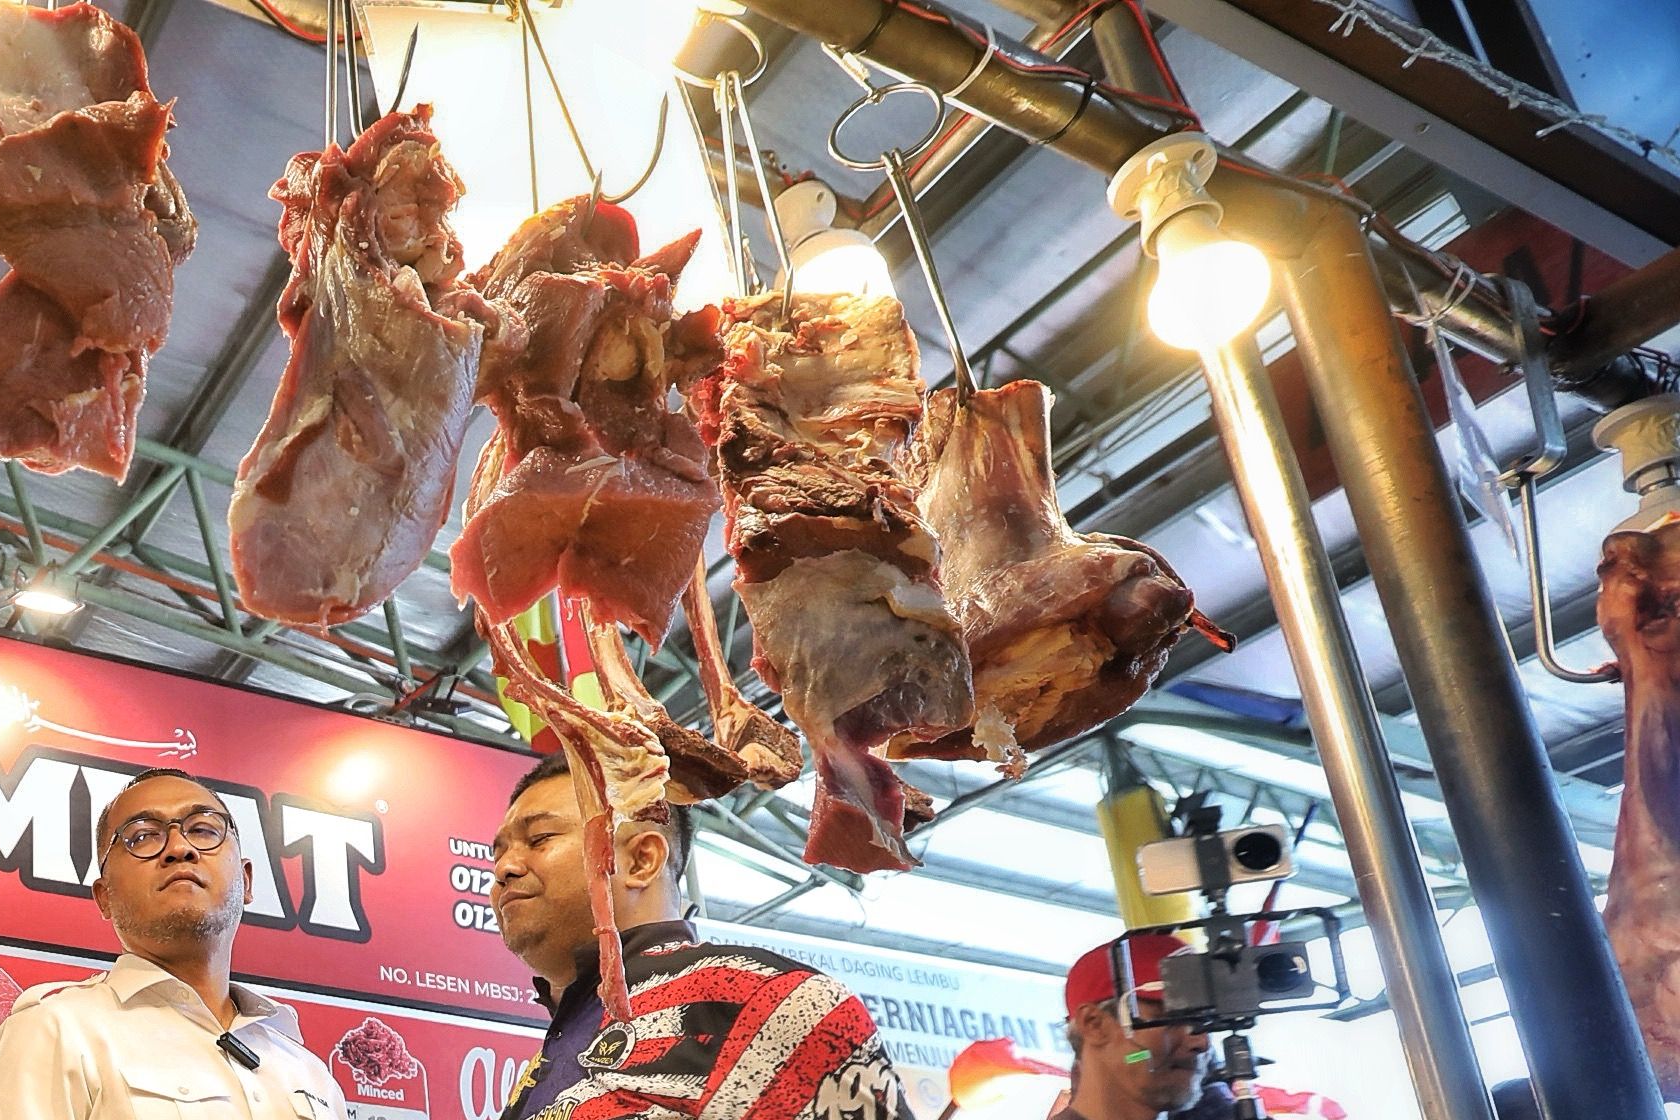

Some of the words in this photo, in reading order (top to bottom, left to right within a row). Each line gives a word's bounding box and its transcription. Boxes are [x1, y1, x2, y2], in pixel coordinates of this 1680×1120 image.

[448, 837, 495, 861] UNTU
[451, 865, 495, 896] 012
[454, 902, 500, 933] 012
[380, 965, 412, 985] NO.
[416, 971, 470, 994] LESEN
[474, 981, 523, 1004] MBSJ:
[842, 957, 905, 982] DAGING
[908, 967, 960, 991] LEMBU
[860, 992, 1042, 1050] ERNIAGAAN
[356, 1083, 405, 1102] Minced
[347, 1109, 357, 1120] M
